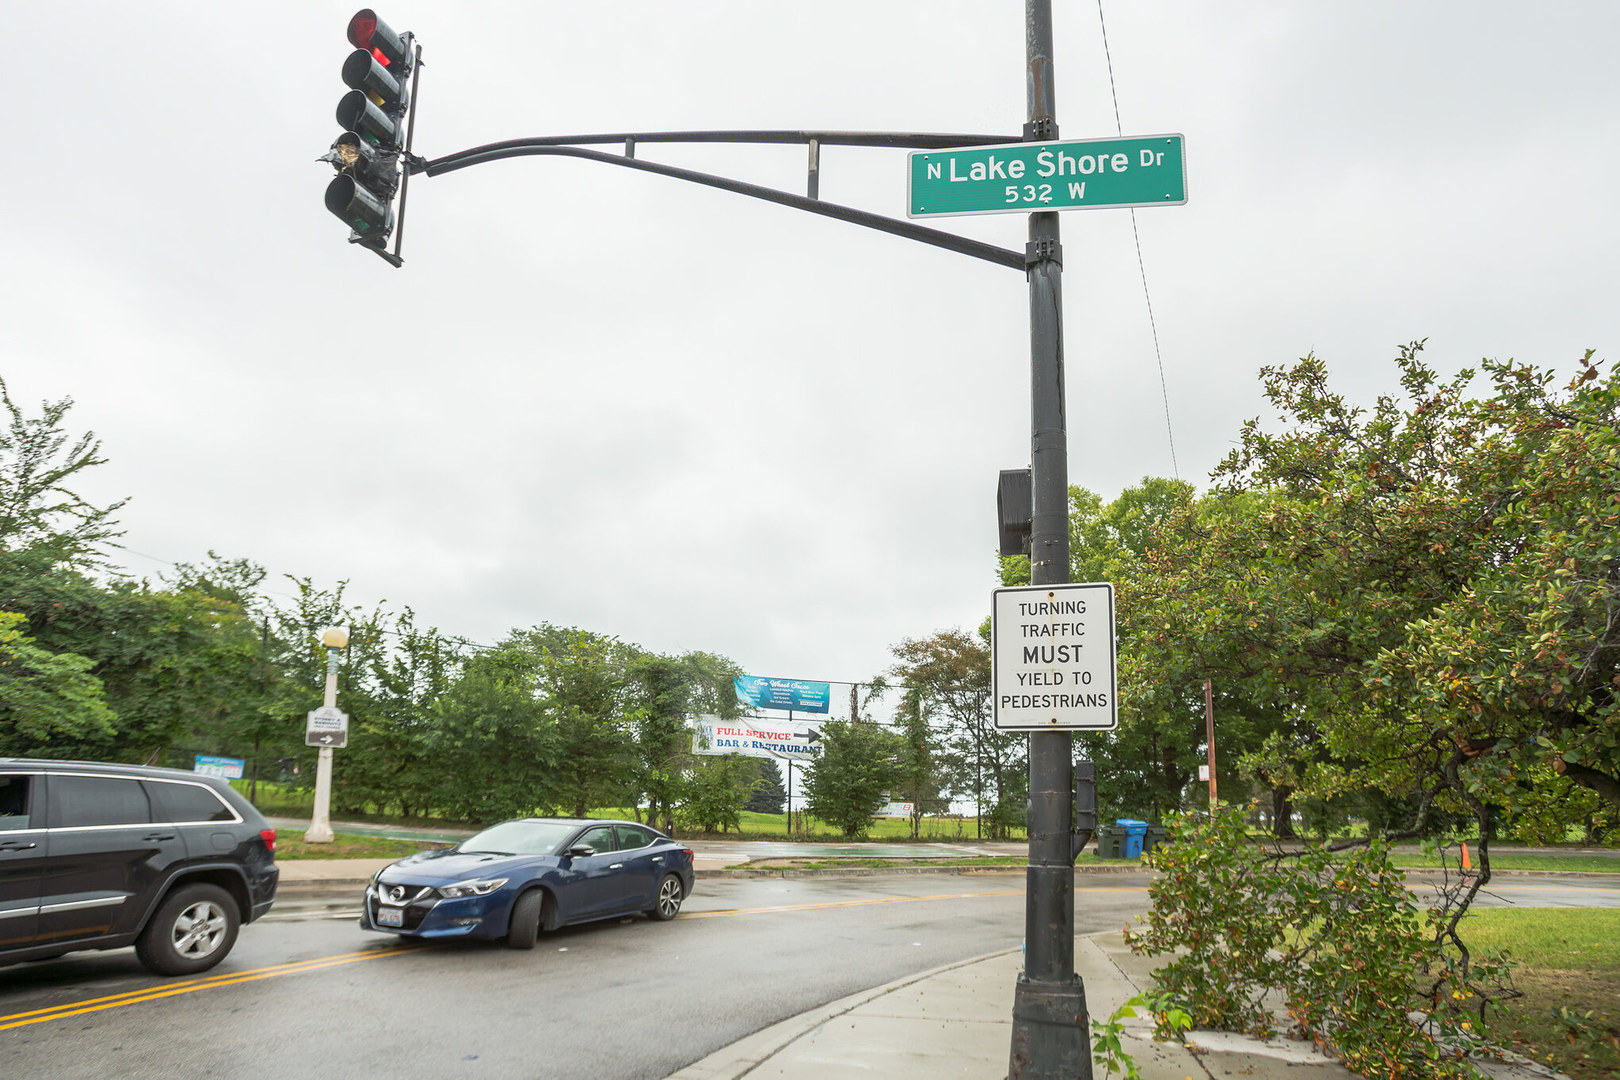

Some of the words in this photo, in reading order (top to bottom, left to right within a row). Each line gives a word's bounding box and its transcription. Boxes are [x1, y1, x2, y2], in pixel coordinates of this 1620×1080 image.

[927, 162, 942, 180] N
[949, 155, 1026, 183] Lake
[1036, 151, 1128, 178] Shore
[1140, 149, 1164, 167] Dr
[1005, 183, 1053, 204] 532
[1068, 181, 1086, 200] W
[1019, 601, 1086, 616] TURNING
[1021, 622, 1085, 638] TRAFFIC
[1023, 645, 1083, 664] MUST
[1016, 672, 1064, 686] YIELD
[1072, 671, 1092, 685] TO
[1002, 694, 1107, 708] PEDESTRIANS
[717, 727, 744, 736] FULL
[746, 729, 791, 741] SERVICE
[717, 739, 739, 747] BAR
